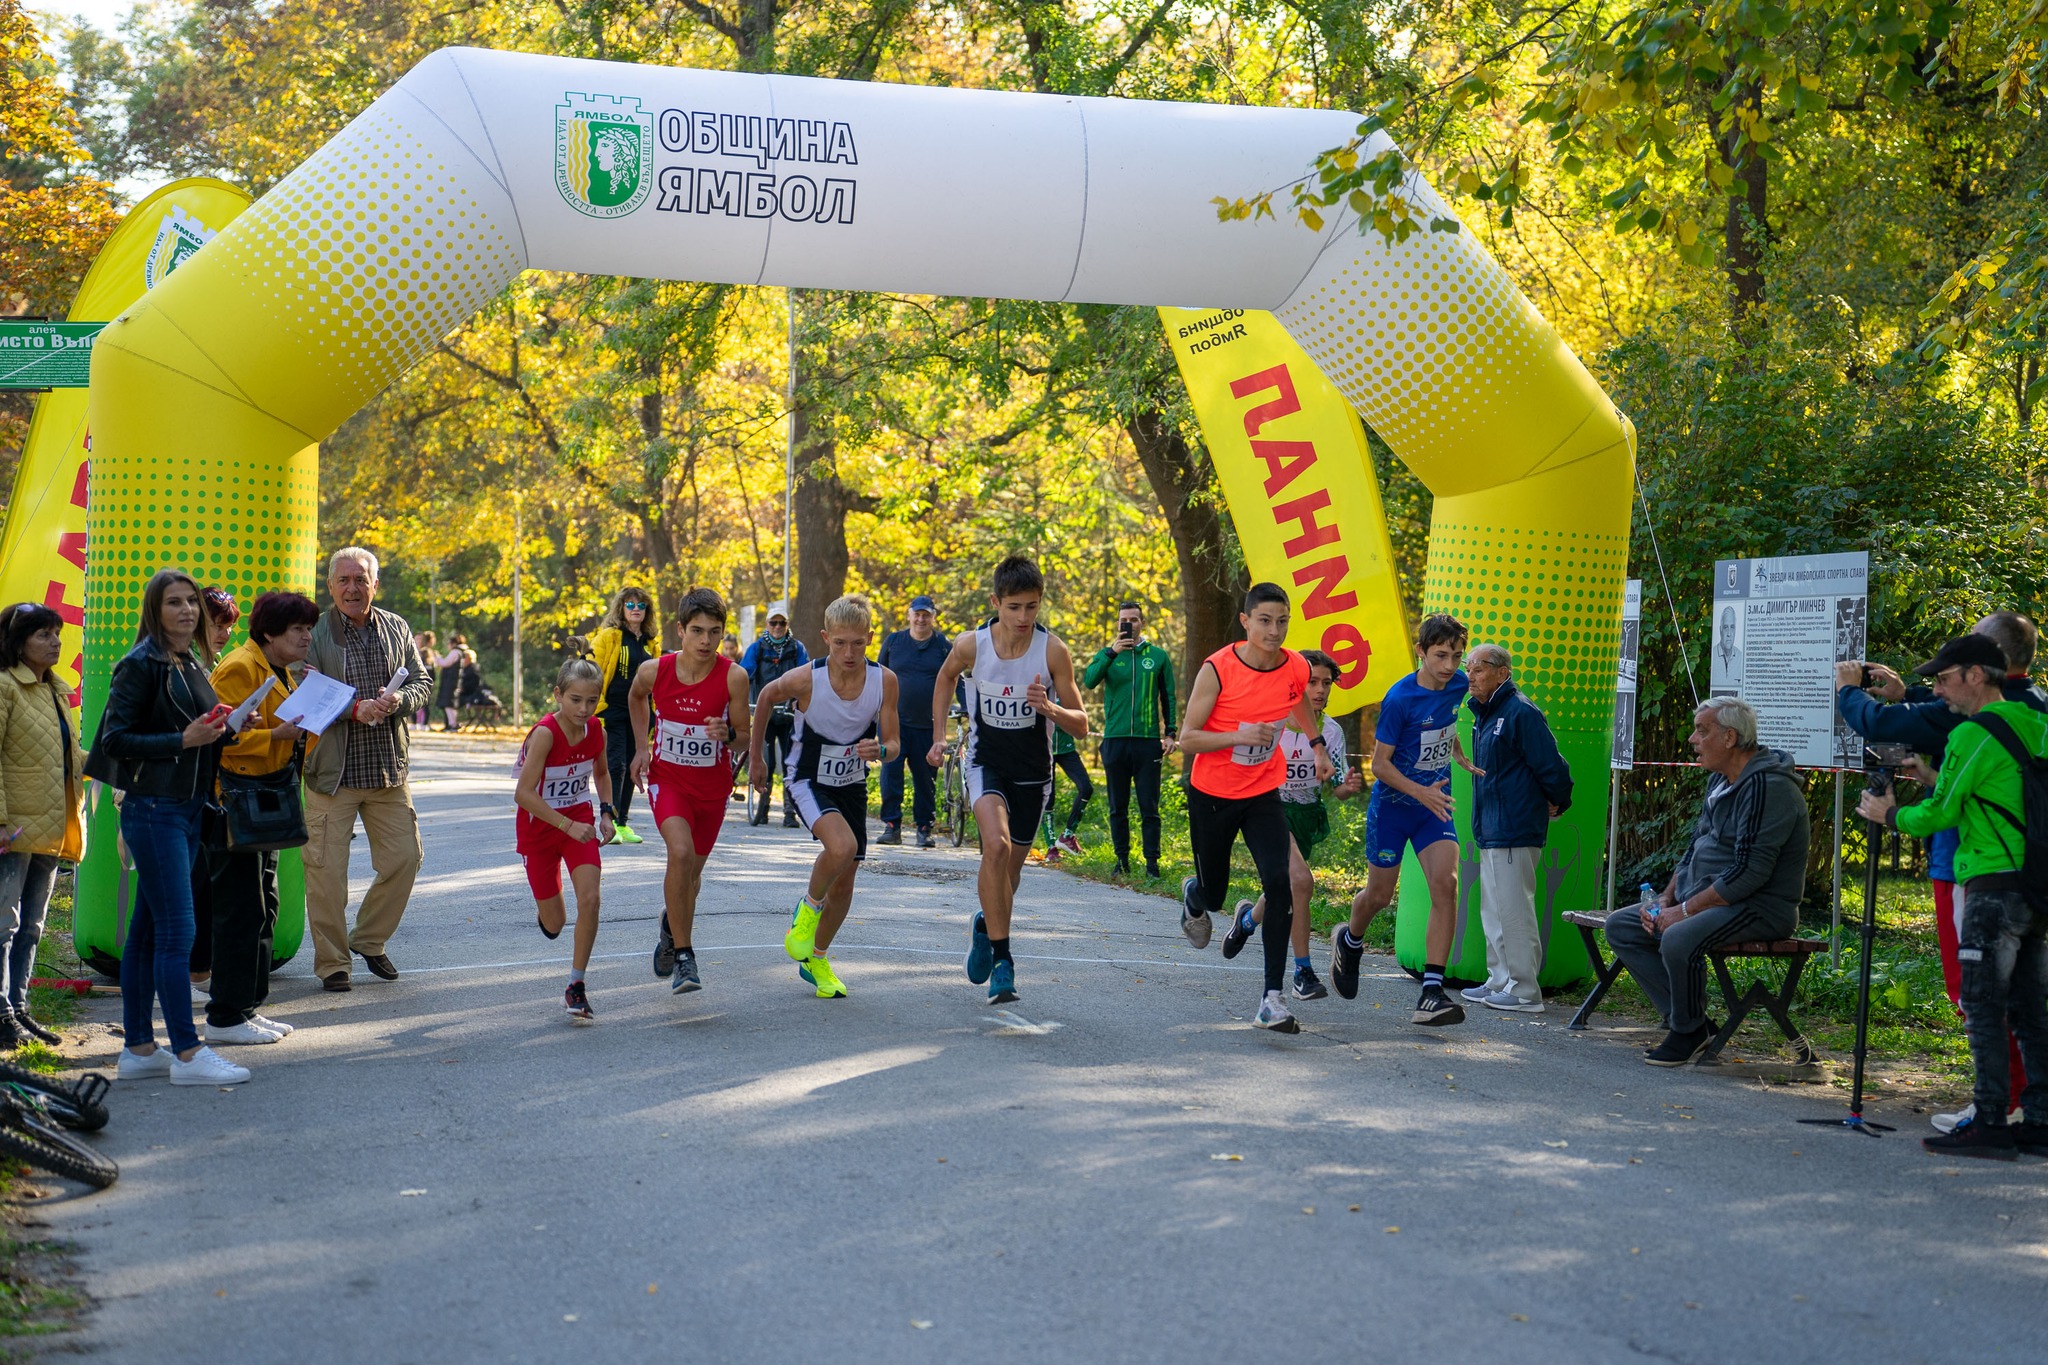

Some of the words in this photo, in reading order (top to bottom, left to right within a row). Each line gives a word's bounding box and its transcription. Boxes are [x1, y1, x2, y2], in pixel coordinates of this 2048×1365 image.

[574, 110, 635, 123] ЯМБОЛ
[659, 108, 858, 169] ОБЩИНА
[558, 144, 567, 159] ОТ
[605, 192, 644, 216] ОТИВАМ
[639, 184, 647, 192] В
[656, 166, 857, 225] ЯМБОЛ
[172, 222, 207, 245] ЯМБО
[1769, 572, 1787, 583] ЗВЕЗДИ
[1788, 572, 1795, 581] НА
[1827, 568, 1849, 580] СПОРТНА
[1849, 567, 1866, 578] СЛАВА
[1766, 600, 1799, 616] ДИМИТЪР
[1799, 599, 1826, 613] МИНЧЕВ
[984, 698, 1033, 717] 1016
[667, 737, 712, 756] 1196
[823, 758, 861, 776] 1021
[547, 776, 588, 797] 1203
